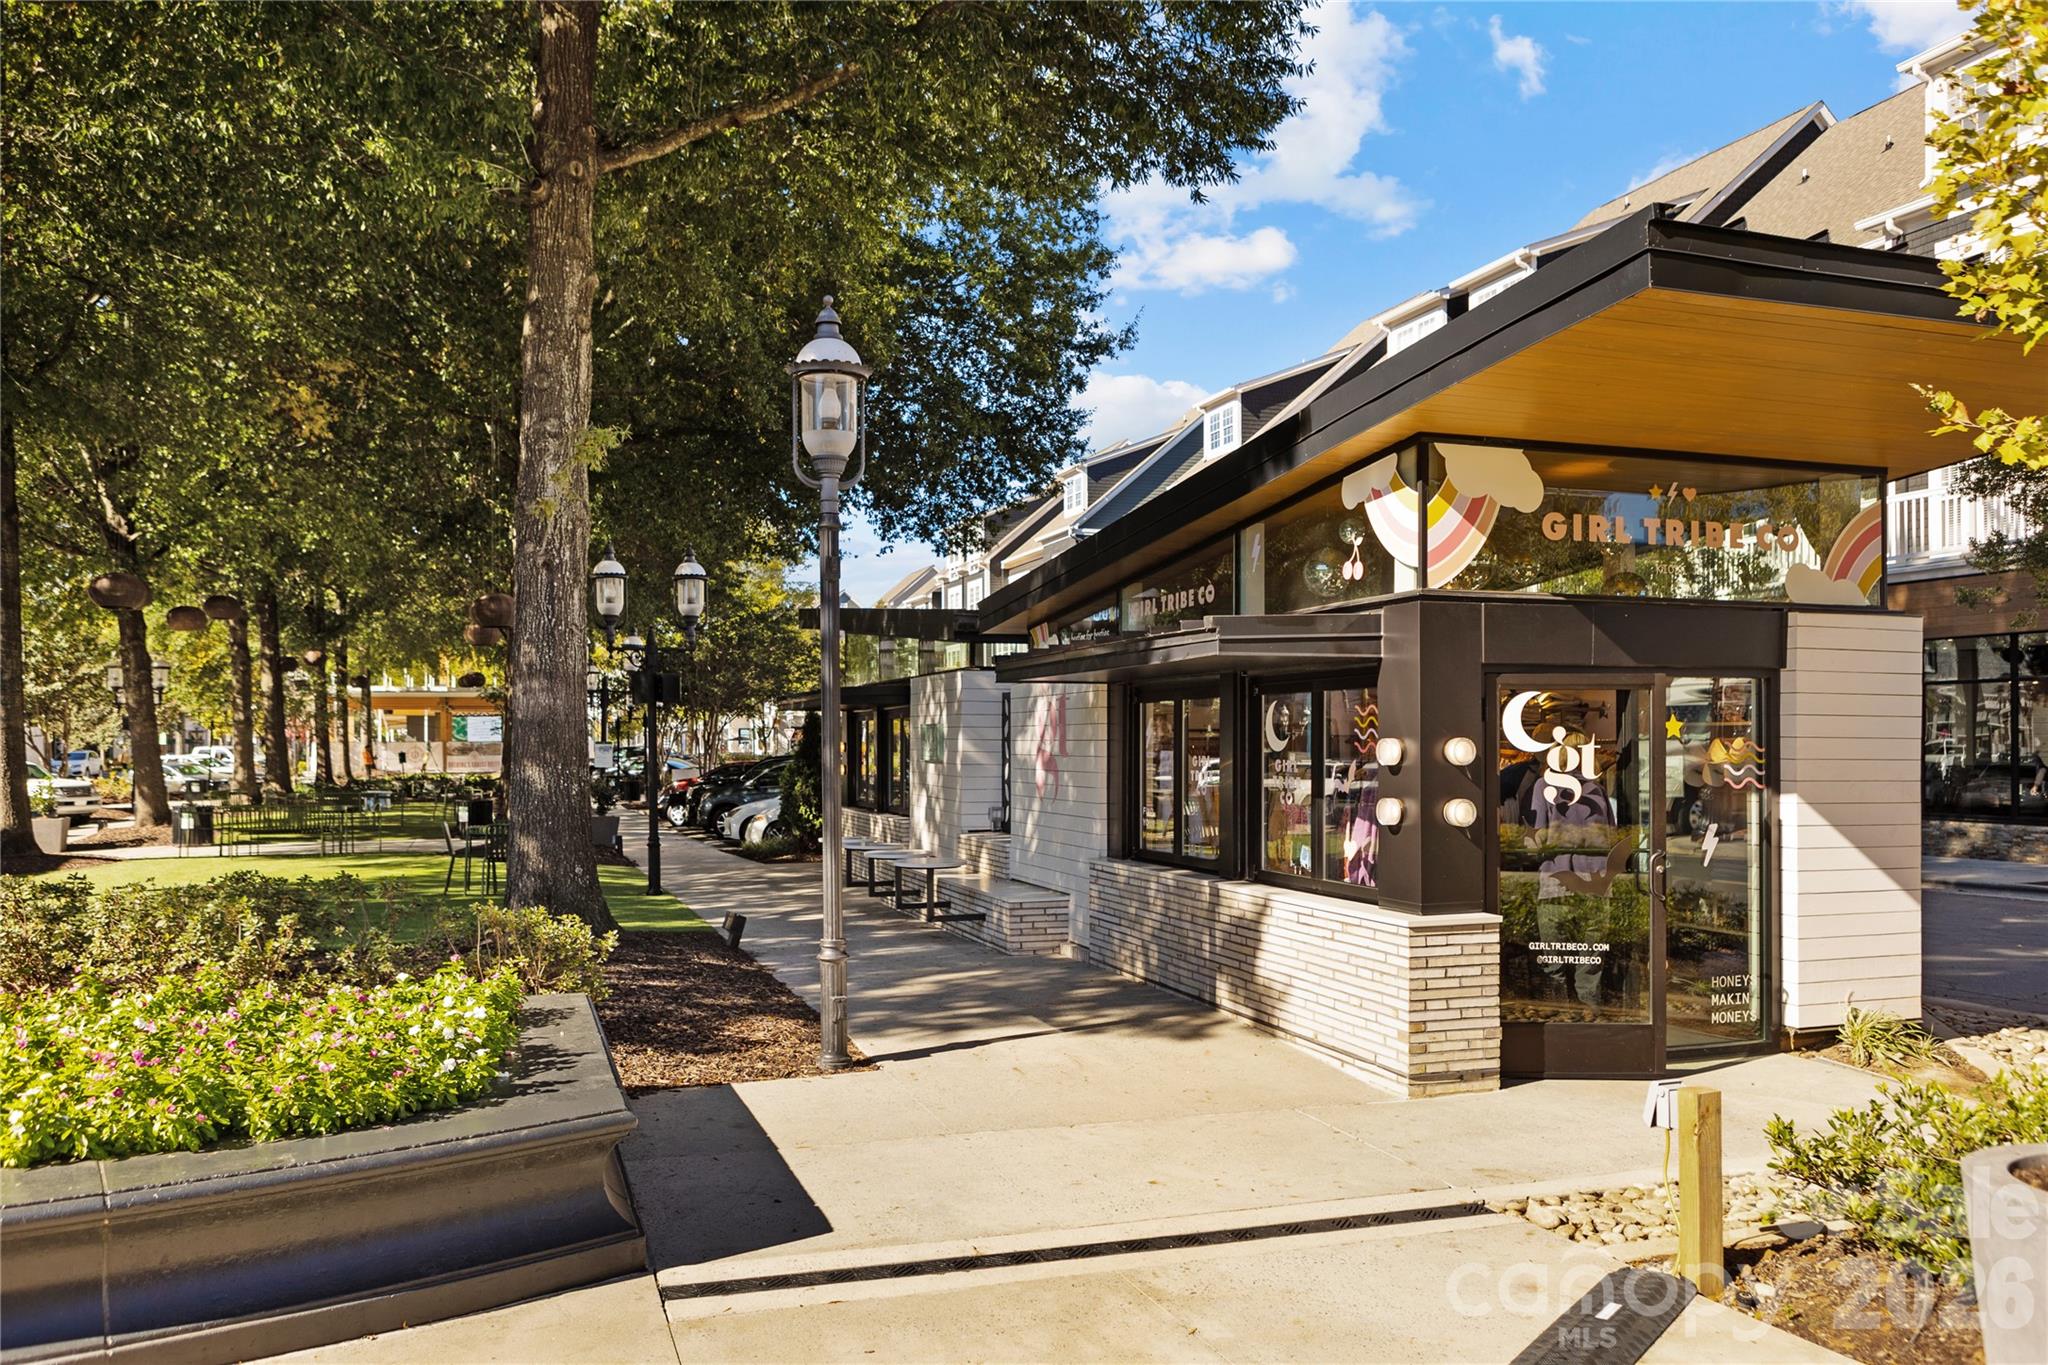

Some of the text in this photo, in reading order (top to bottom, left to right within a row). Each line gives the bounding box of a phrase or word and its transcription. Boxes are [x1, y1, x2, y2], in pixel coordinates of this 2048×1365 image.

[1541, 511, 1800, 552] GIRL TRIBE CO
[1131, 597, 1158, 617] GIRL
[1161, 588, 1195, 613] TRIBE
[1198, 584, 1215, 606] CO
[1275, 759, 1298, 772] GIRL
[1280, 791, 1293, 805] CO
[1528, 942, 1610, 951] GIRLTRIBECO.COM
[1536, 955, 1602, 965] @GIRLTRIBECO
[1711, 974, 1757, 988] HONEYS
[1711, 992, 1750, 1006] MAKIN
[1711, 1010, 1757, 1025] MONEYS
